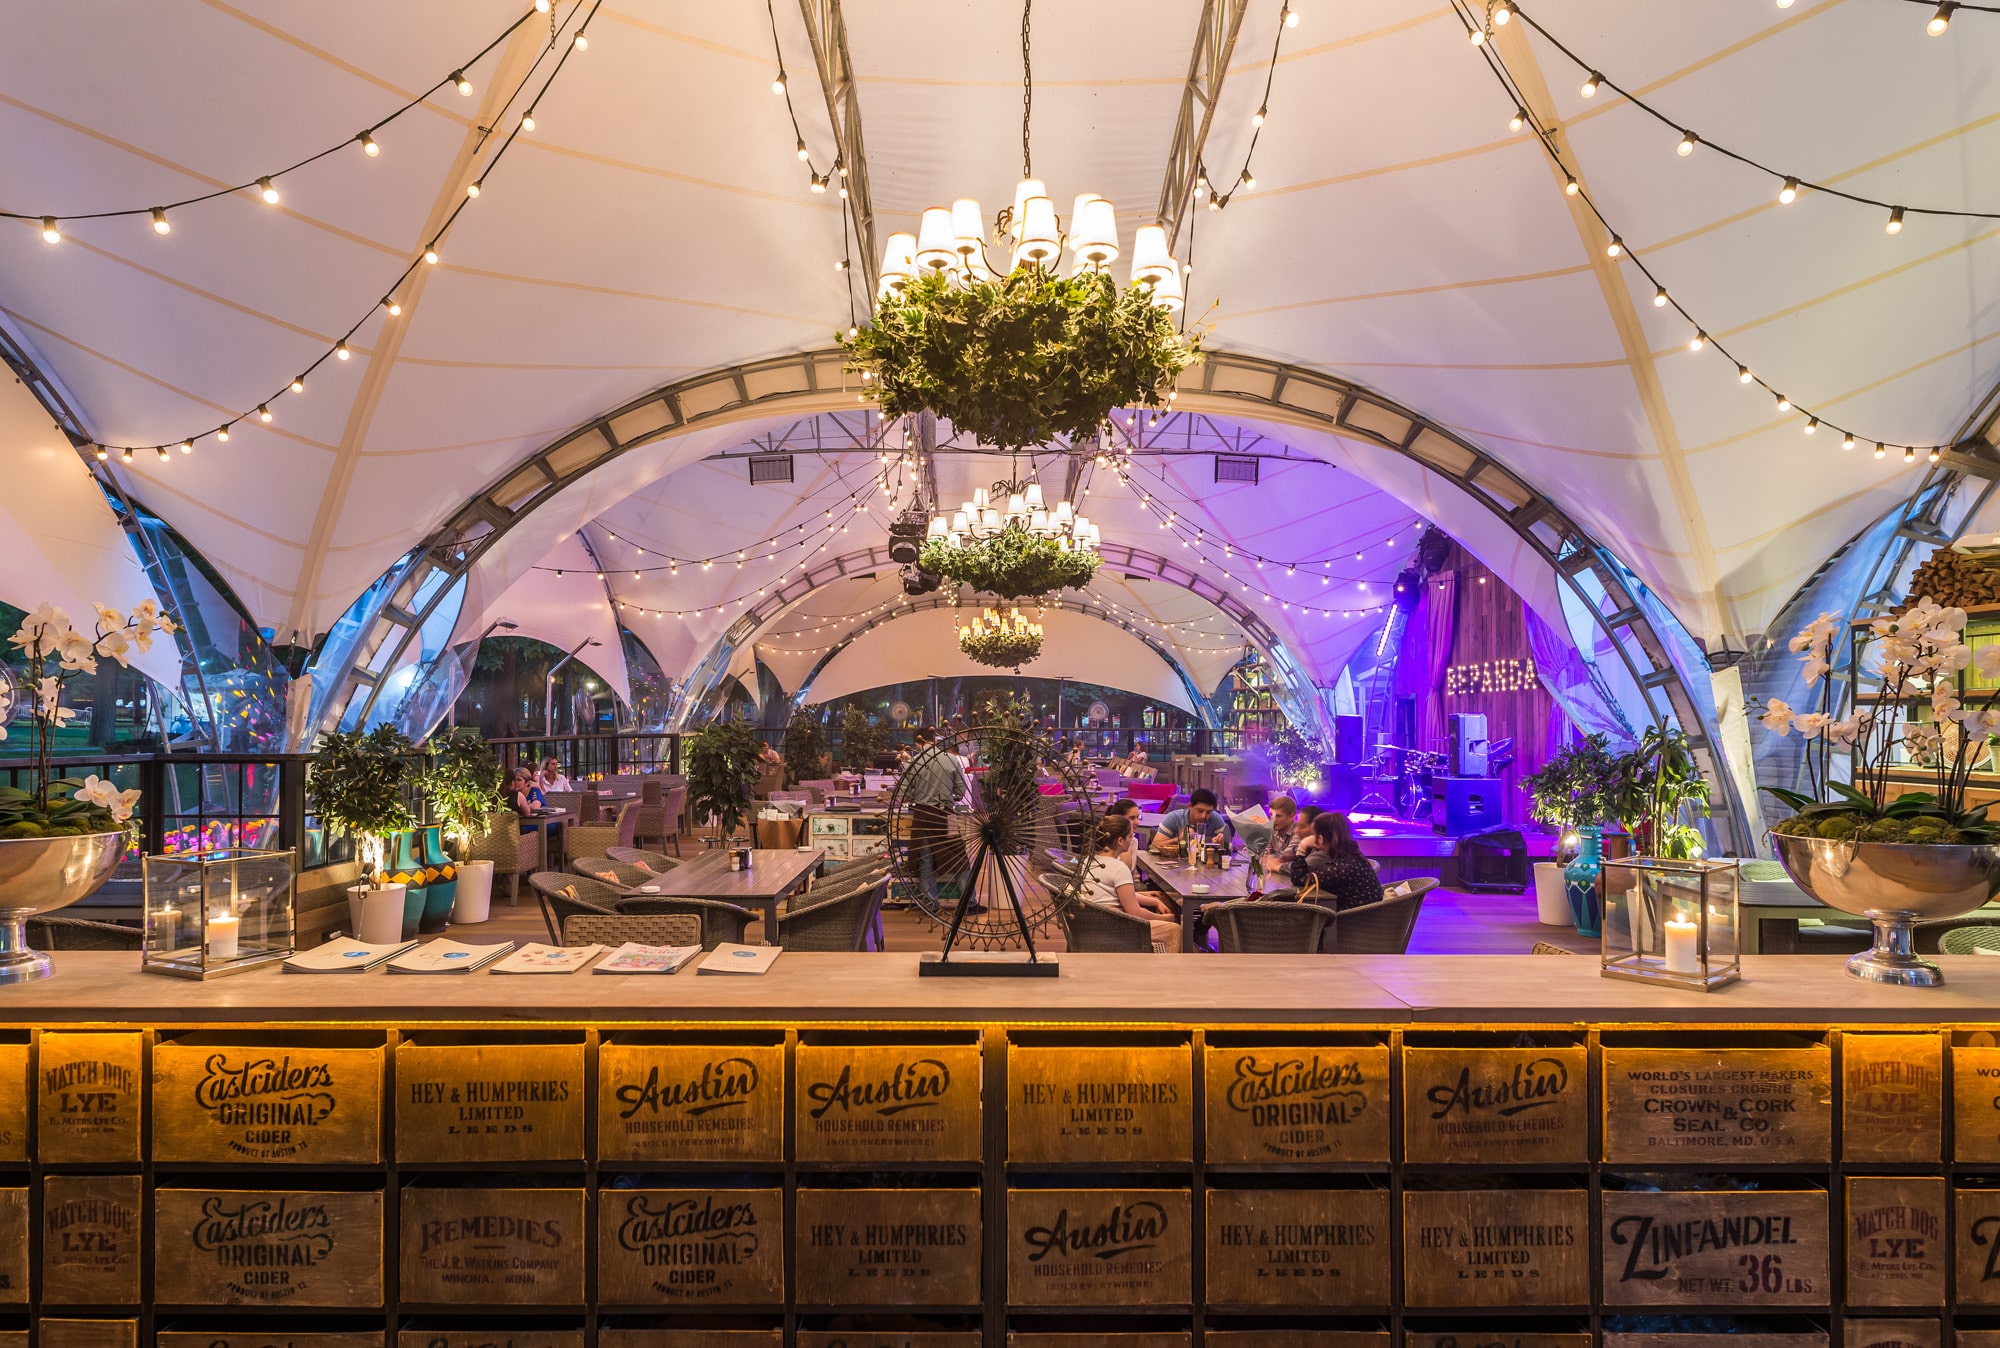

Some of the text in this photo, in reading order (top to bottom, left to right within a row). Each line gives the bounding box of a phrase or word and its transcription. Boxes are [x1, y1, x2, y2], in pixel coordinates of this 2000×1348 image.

[46, 1062, 132, 1096] WATCH DOG
[195, 1054, 333, 1110] Eastciders
[1226, 1056, 1365, 1112] Eastciders
[1628, 1070, 1814, 1081] WORLD'S LARGEST MAKERS
[1851, 1061, 1933, 1094] WATCH DOG
[411, 1081, 569, 1104] HEY & HUMPHRIES
[616, 1058, 759, 1119] Austin
[807, 1059, 950, 1119] Austin
[1023, 1083, 1178, 1105] HEY & HUMPHRIES
[1427, 1058, 1568, 1119] Austin
[1650, 1084, 1725, 1094] CLOSURES
[60, 1093, 116, 1113] LYE
[1644, 1098, 1797, 1120] CROWN & CORK
[1864, 1093, 1919, 1112] LYE
[219, 1103, 318, 1125] ORIGINAL
[458, 1106, 525, 1121] LIMITED
[1071, 1108, 1134, 1122] LIMITED
[1252, 1102, 1352, 1127] ORIGINAL
[448, 1125, 533, 1135] LEEDS
[626, 1118, 754, 1134] HOUSEHOLD REMEDIES
[816, 1119, 945, 1133] HOUSEHOLD REMEDIES
[1059, 1127, 1143, 1135] LEEDS
[1673, 1117, 1726, 1132] SEAL
[245, 1130, 291, 1144] CIDER
[1279, 1130, 1325, 1144] CIDER
[46, 1200, 131, 1235] WATCH DOG
[192, 1196, 331, 1252] Eastciders
[618, 1196, 757, 1251] Eastciders
[1855, 1206, 1939, 1242] WATCH DOG
[420, 1216, 563, 1253] REMEDIES
[811, 1225, 967, 1246] HEY & HUMPHRIES
[1024, 1201, 1168, 1262] Austin
[1220, 1225, 1375, 1246] HEY & HUMPHRIES
[1420, 1225, 1574, 1248] HEY & HUMPHRIES
[62, 1232, 117, 1252] LYE
[1610, 1215, 1797, 1282] ZINFANDEL
[1870, 1238, 1925, 1258] LYE
[217, 1244, 317, 1267] ORIGINAL
[512, 1257, 559, 1270] COMPANY
[643, 1243, 743, 1266] ORIGINAL
[858, 1250, 922, 1263] LIMITED
[1268, 1250, 1331, 1263] LIMITED
[1468, 1250, 1530, 1265] LIMITED
[243, 1271, 290, 1285] CIDER
[669, 1270, 716, 1284] CIDER
[847, 1268, 931, 1277] LEEDS
[1034, 1261, 1162, 1276] HOUSEHOLD REMEDIES
[1257, 1268, 1341, 1277] LEEDS
[1457, 1270, 1540, 1278] LEEDS
[1679, 1278, 1705, 1293] NET
[1738, 1254, 1782, 1294] 36
[1786, 1279, 1817, 1293] LBS.
